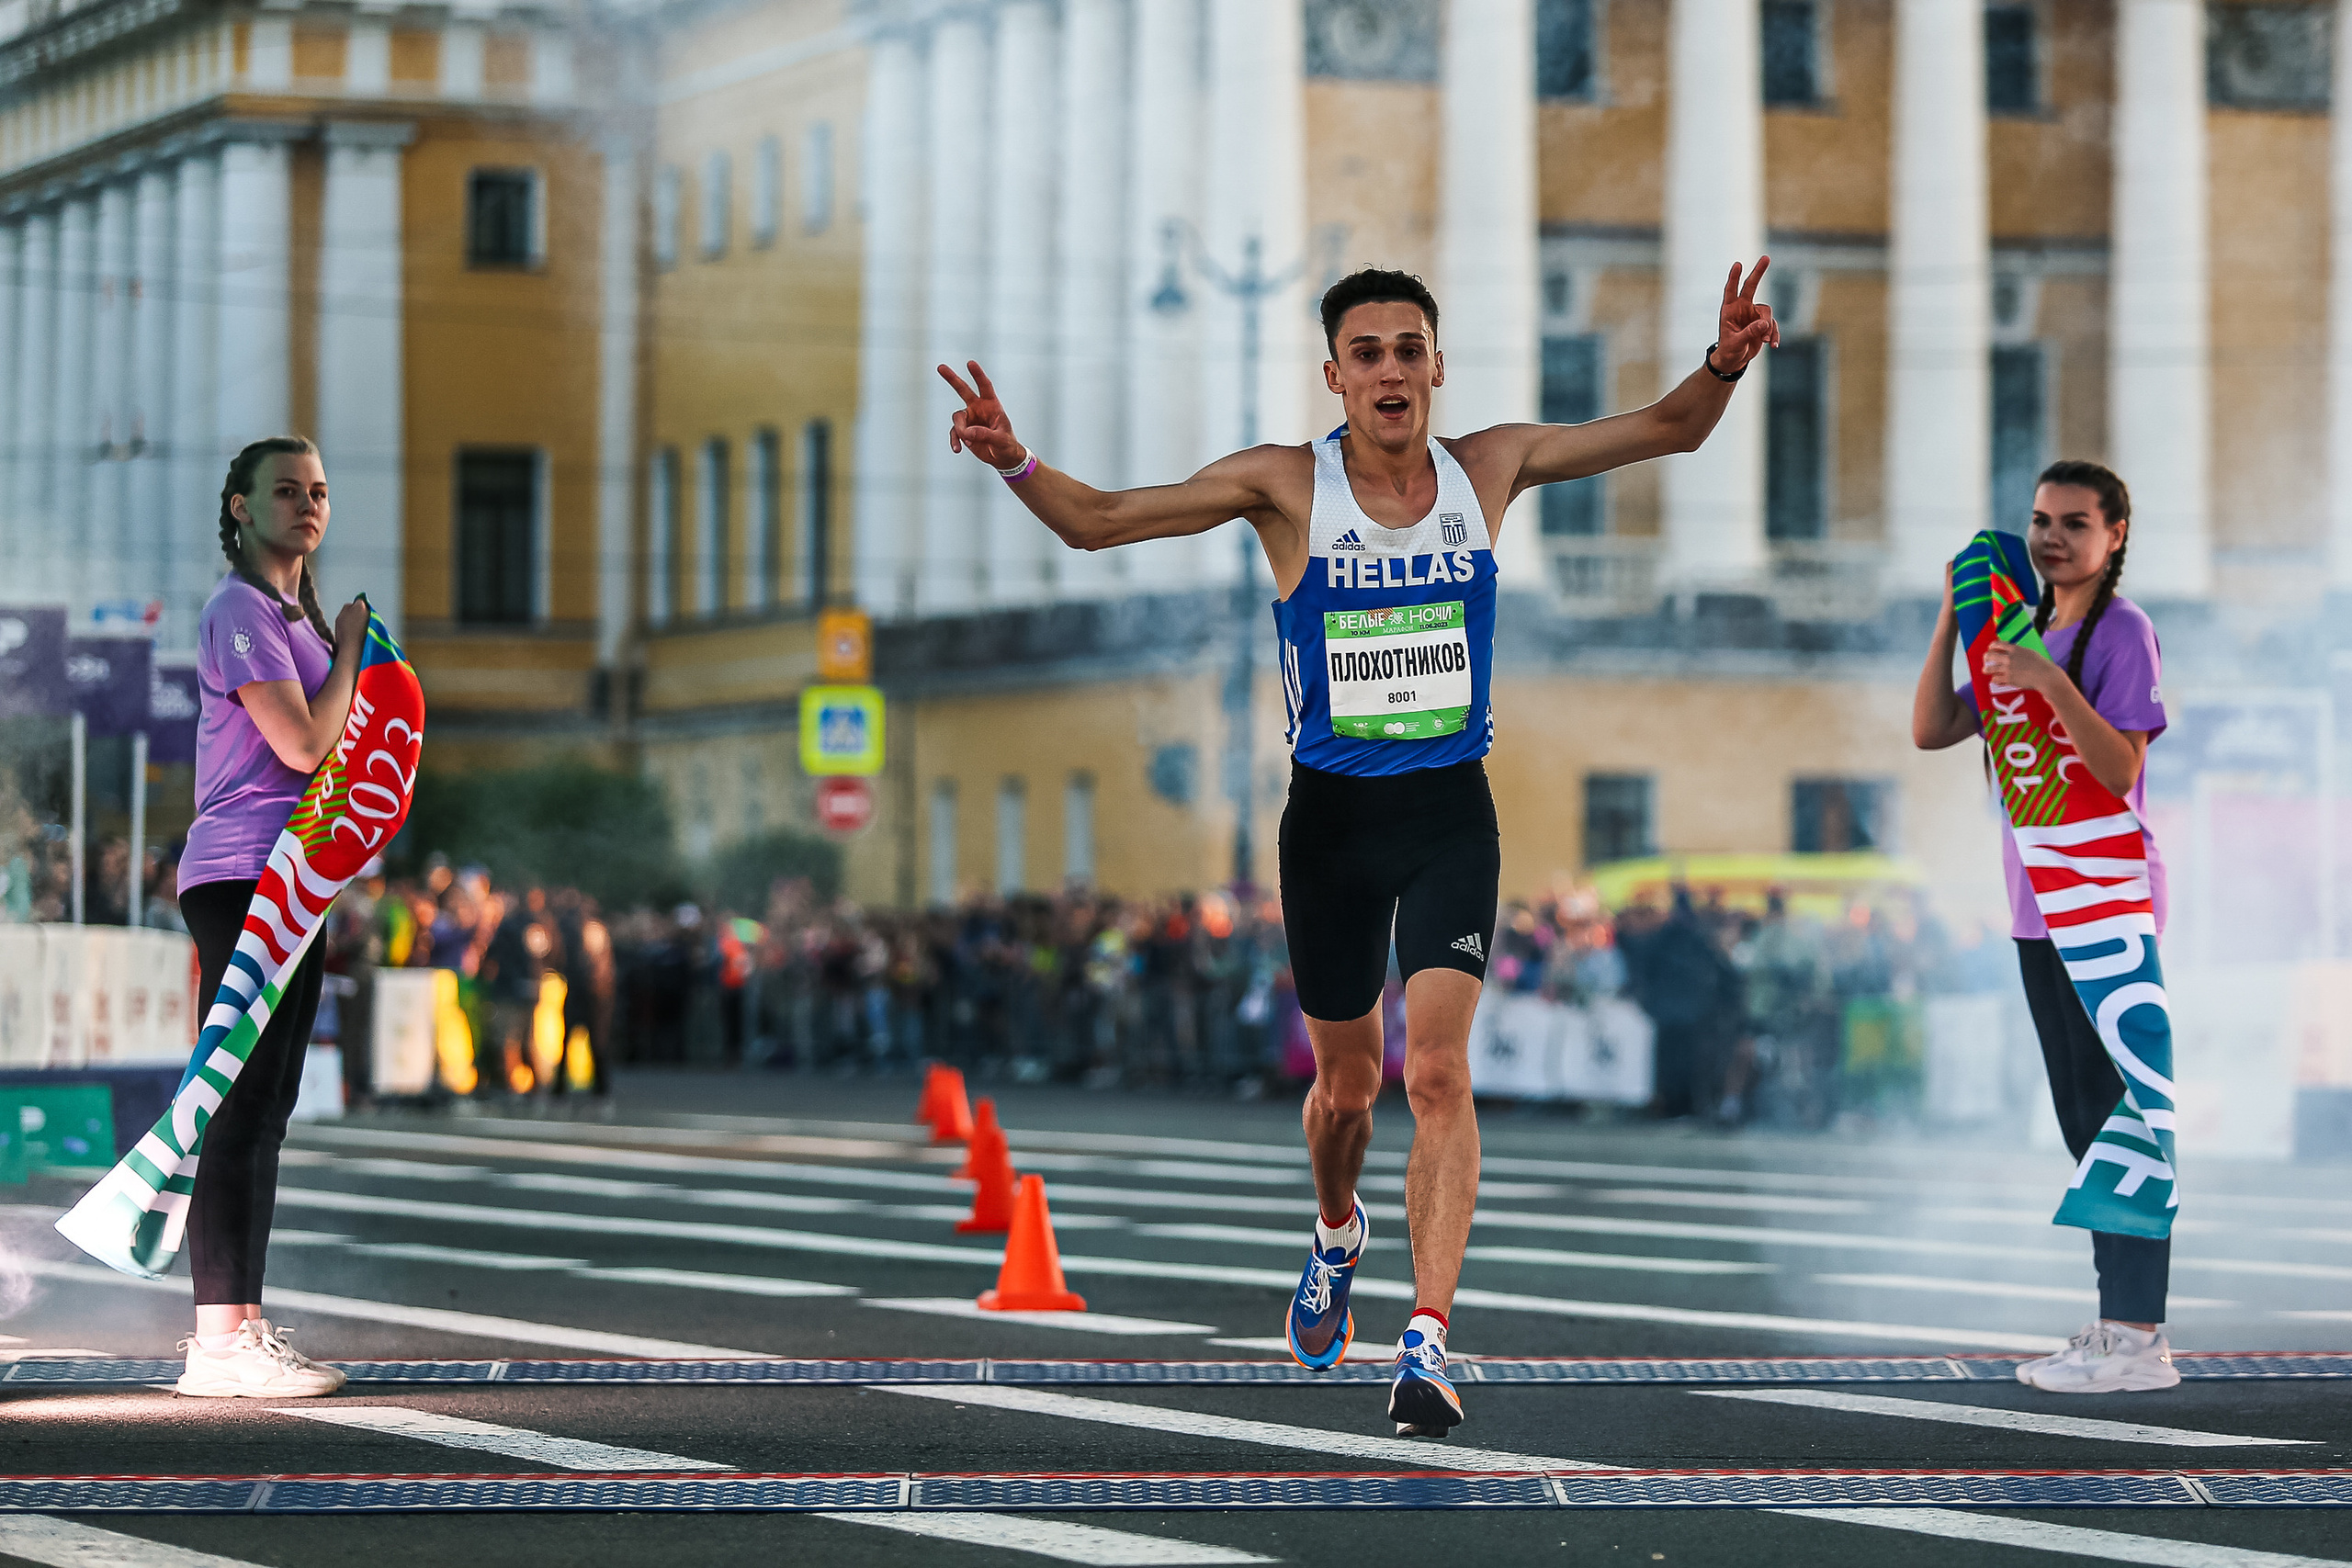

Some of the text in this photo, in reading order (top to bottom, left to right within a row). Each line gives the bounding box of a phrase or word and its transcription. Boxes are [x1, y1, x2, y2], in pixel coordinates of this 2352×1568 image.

[1332, 541, 1366, 551] adidas
[1327, 550, 1476, 589] HELLAS
[1339, 606, 1453, 630] БЕЛЫЕ НОЧИ
[1331, 642, 1466, 682] ПЛОХОТНИКОВ
[1387, 691, 1418, 704] 8001
[331, 716, 424, 850] 2023
[2004, 741, 2043, 795] 10
[1451, 942, 1485, 962] adidas
